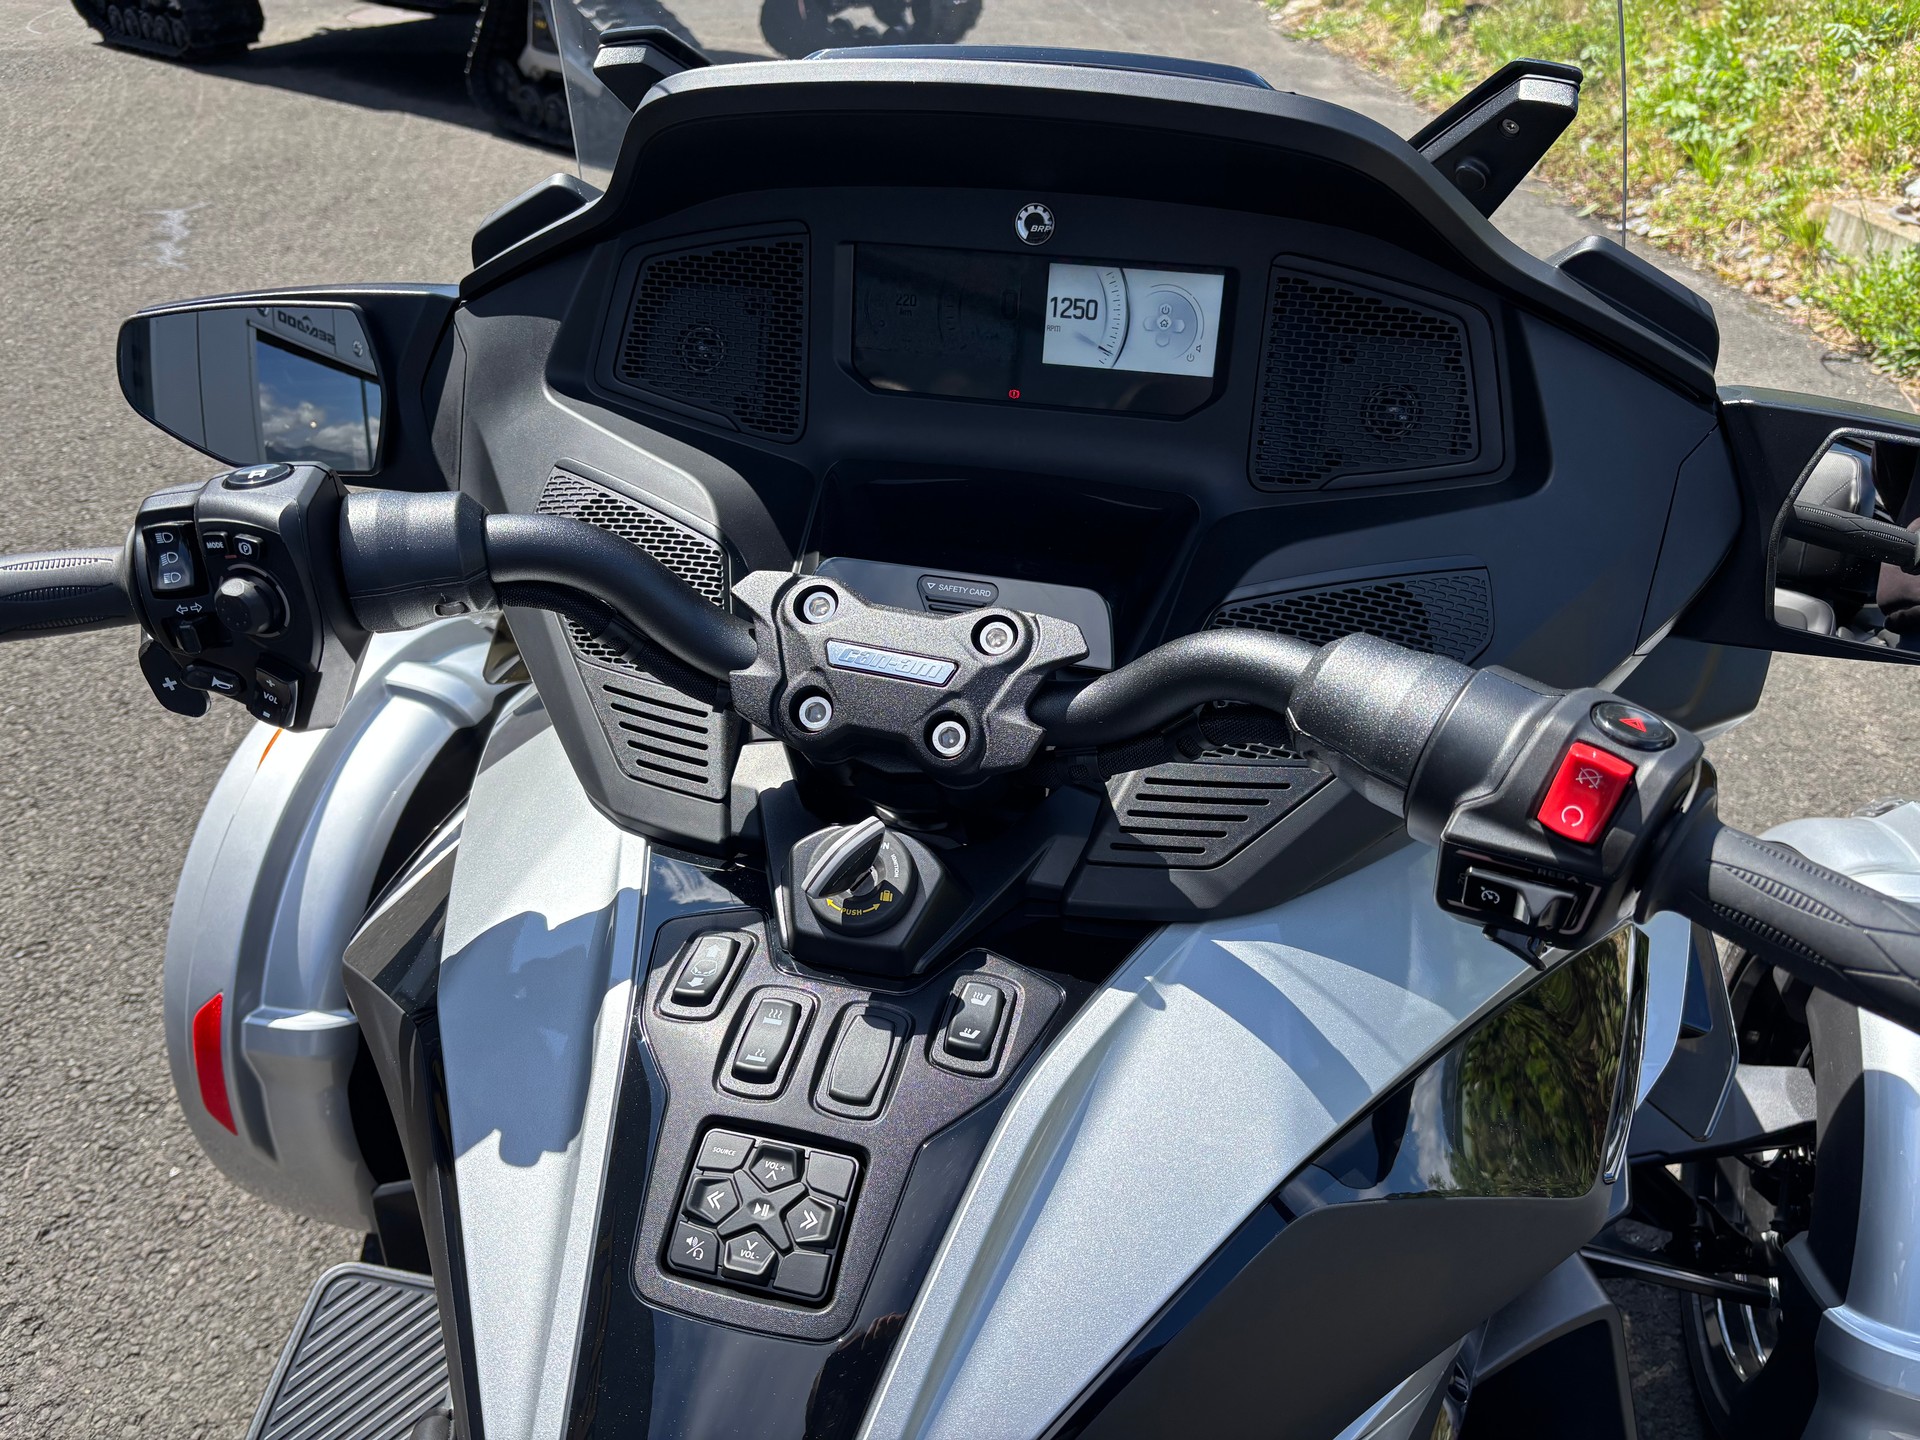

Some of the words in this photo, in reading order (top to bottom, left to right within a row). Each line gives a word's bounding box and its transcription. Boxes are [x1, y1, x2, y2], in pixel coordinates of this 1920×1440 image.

[1030, 224, 1052, 233] BRP
[895, 294, 917, 307] 220
[1049, 295, 1098, 321] 1250
[1046, 323, 1062, 334] RPM
[247, 469, 267, 479] R
[206, 541, 224, 549] MODE
[937, 583, 969, 596] SAFETY
[969, 586, 991, 599] CARD
[263, 691, 278, 705] VOL
[890, 853, 900, 878] IGNITION
[840, 907, 863, 916] PUSH
[711, 1145, 736, 1157] SOURCE
